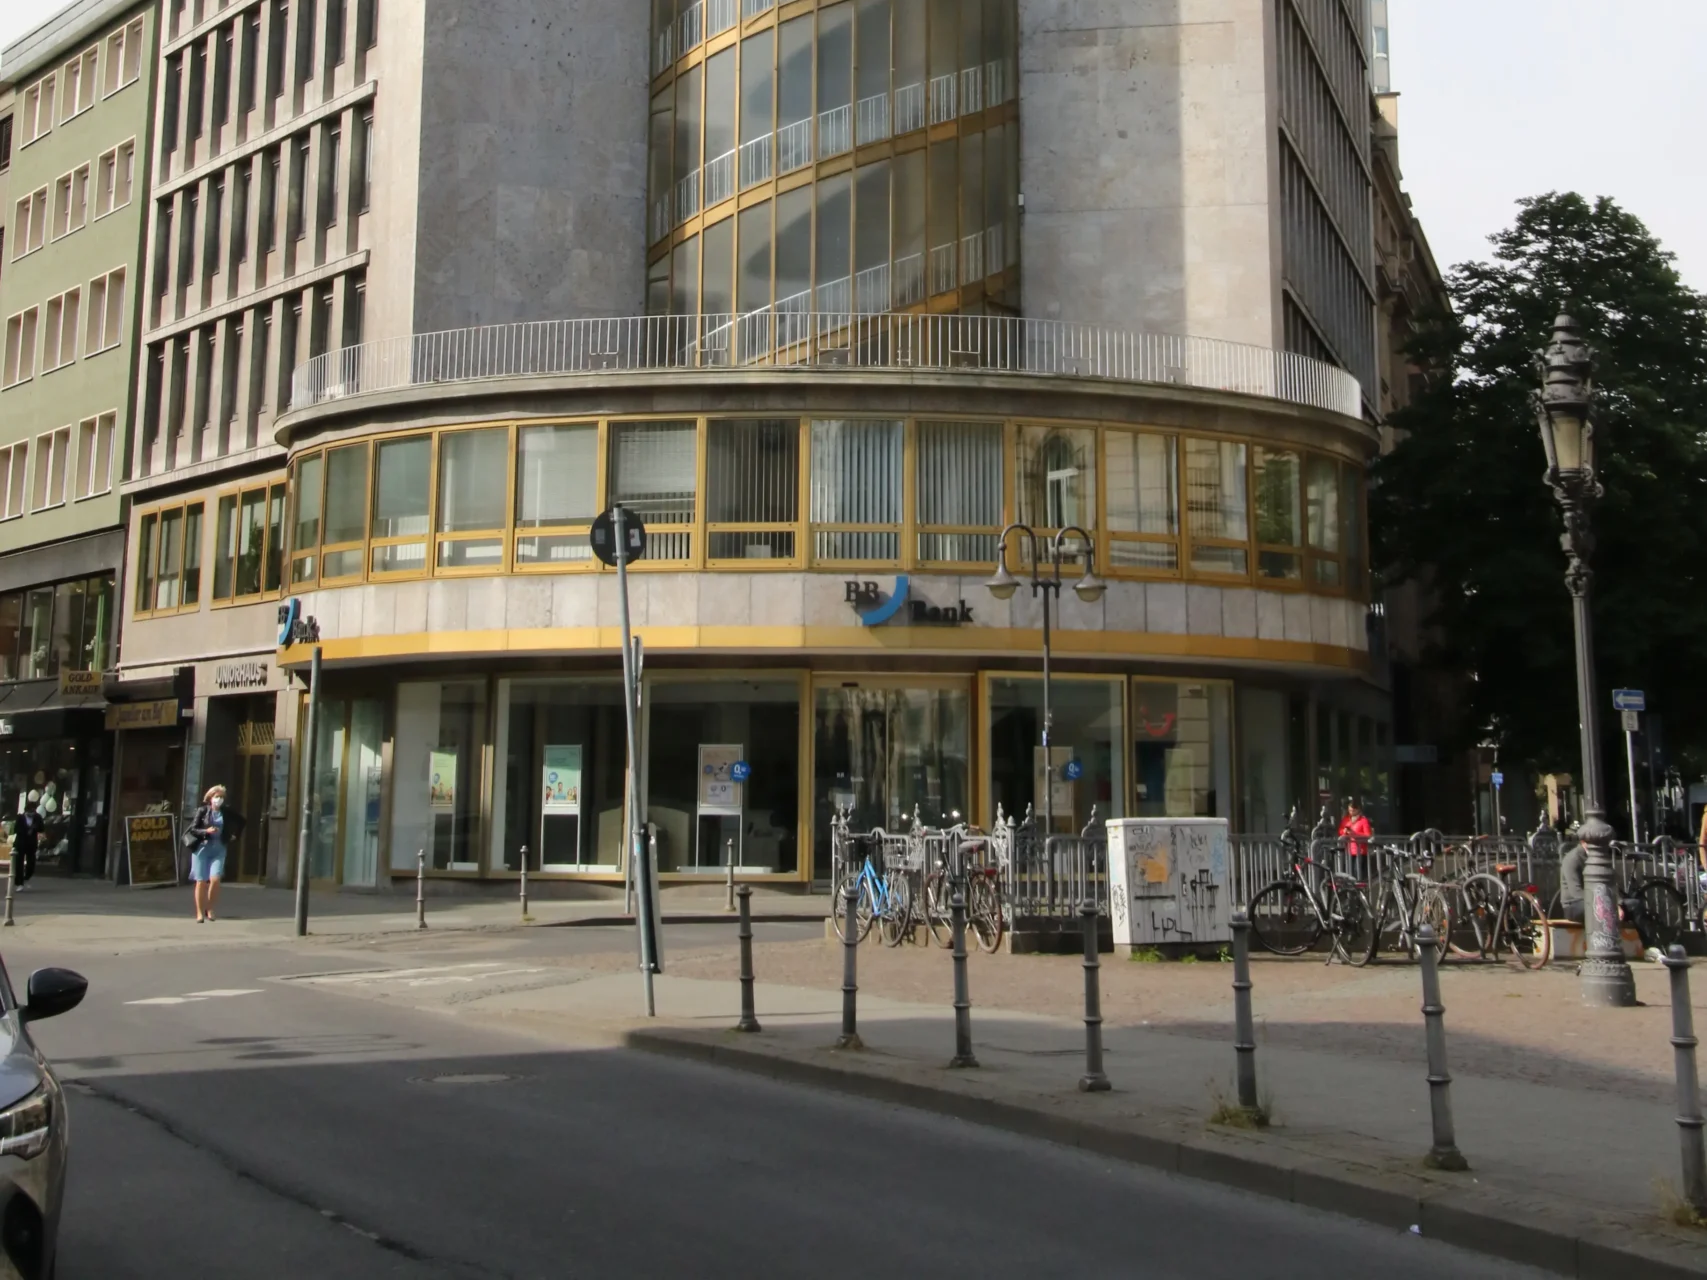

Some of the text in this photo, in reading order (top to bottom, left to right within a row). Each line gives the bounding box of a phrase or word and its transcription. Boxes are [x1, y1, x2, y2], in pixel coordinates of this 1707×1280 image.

[844, 581, 880, 602] BB
[908, 599, 974, 623] Bank
[215, 663, 265, 686] JUNIORHAUS
[131, 817, 168, 830] GOLD
[130, 829, 172, 841] ANKAUF
